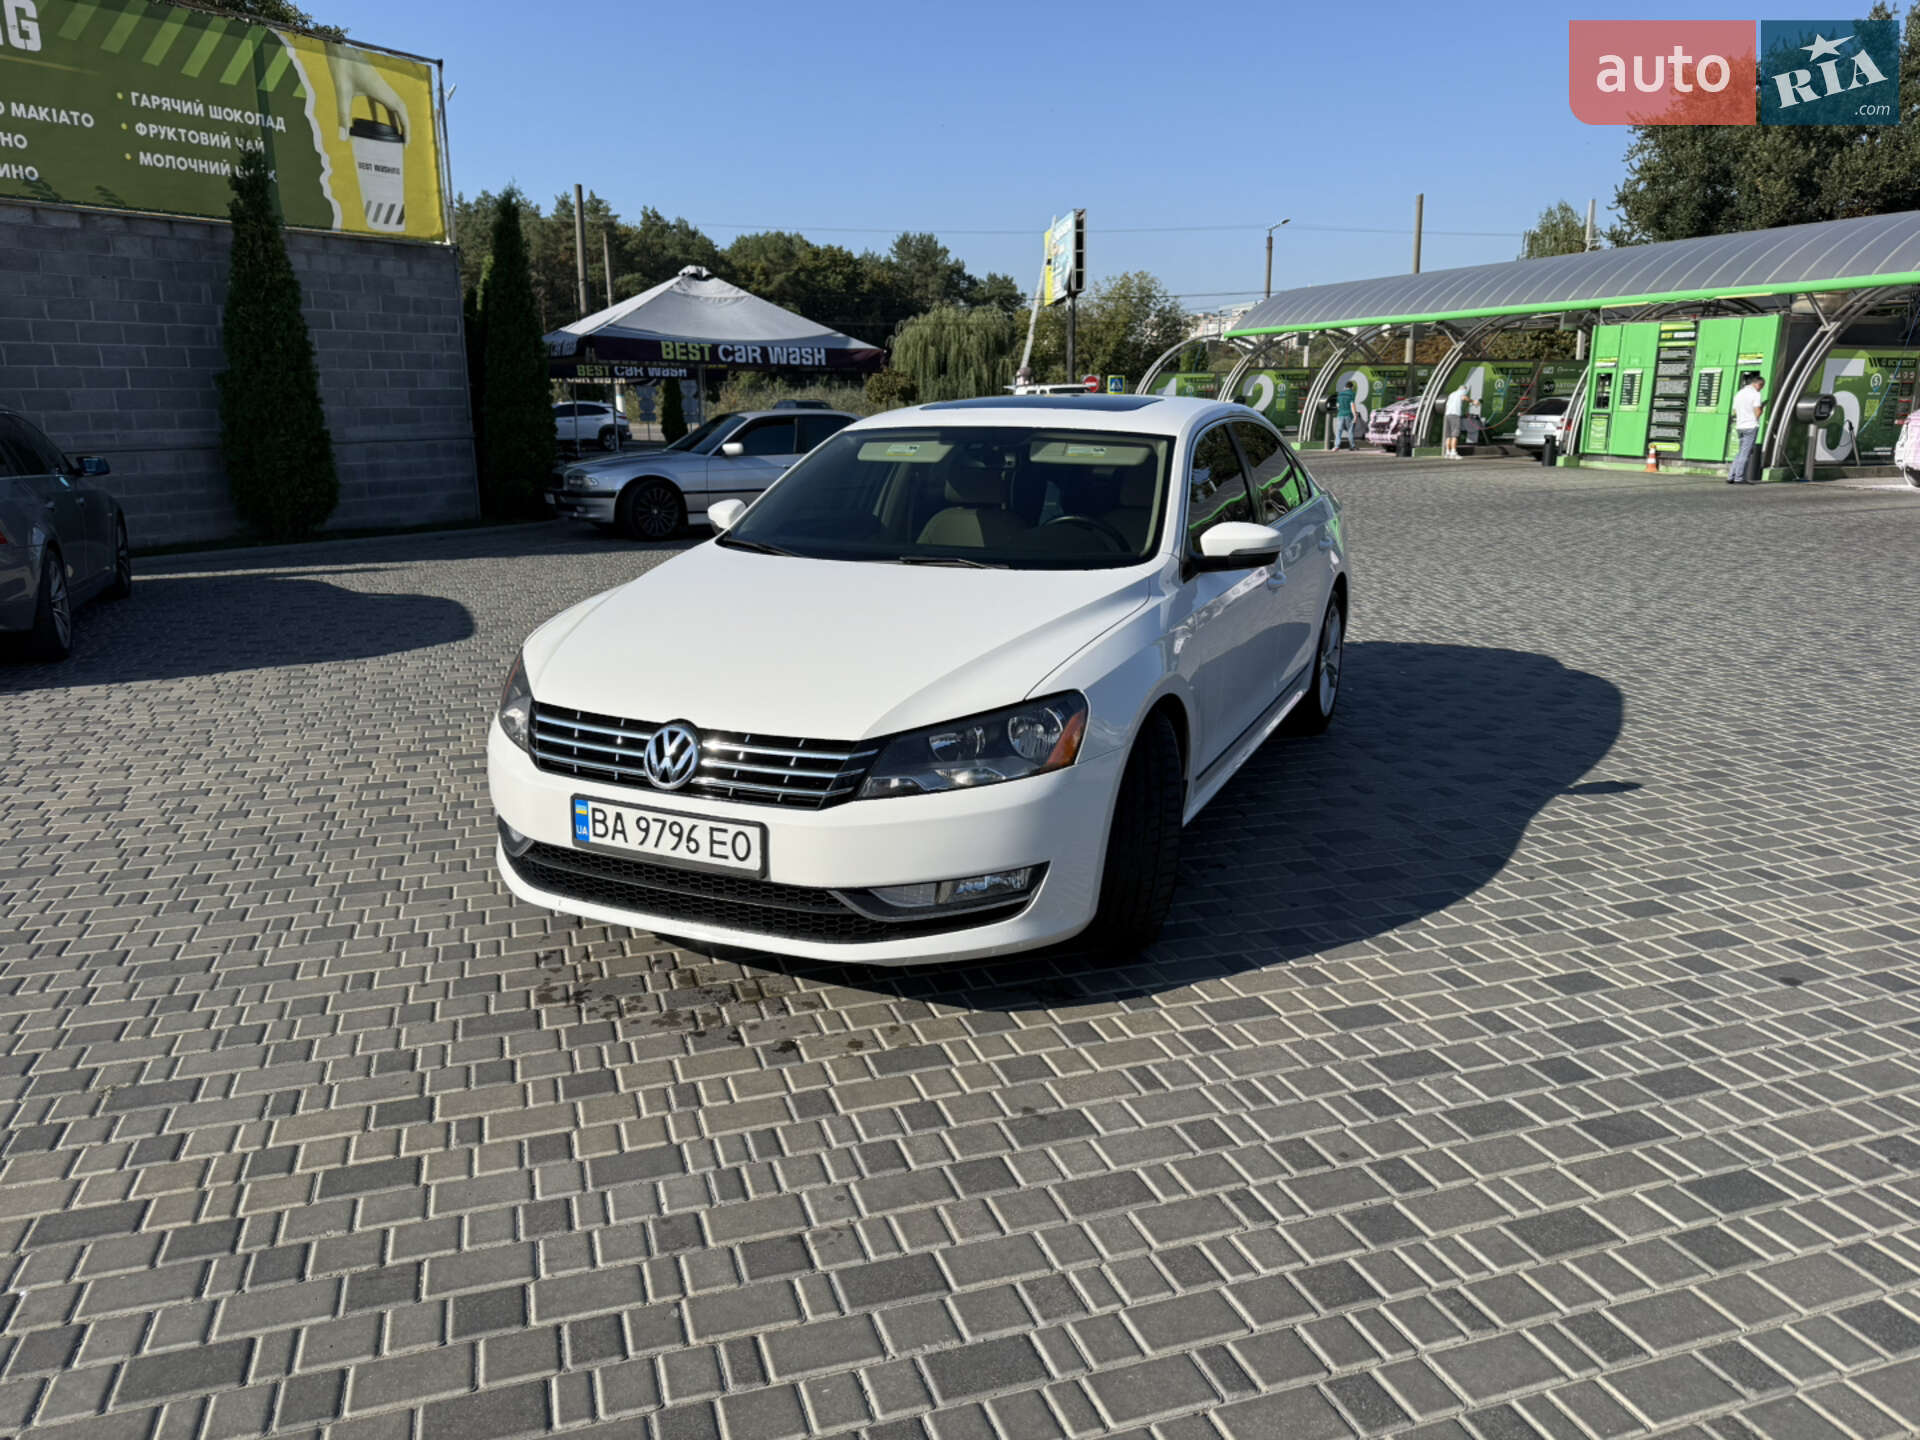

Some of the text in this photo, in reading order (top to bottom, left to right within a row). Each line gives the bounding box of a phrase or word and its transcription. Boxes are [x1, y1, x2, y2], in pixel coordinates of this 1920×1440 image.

[0, 0, 42, 52] G
[11, 102, 94, 128] МАКІАТО
[131, 91, 287, 133] ГАРЯЧИЙ ШОКОЛАД
[135, 122, 265, 154] ФРУКТОВИЙ ЧАЙ
[139, 151, 232, 177] МОЛОЧНИЙ
[660, 341, 713, 361] BEST
[576, 364, 611, 377] BEST
[1242, 374, 1274, 413] 2
[1335, 370, 1370, 440] 3
[1815, 358, 1865, 462] 5
[575, 823, 589, 836] UA
[591, 807, 752, 862] BA 9796 EO
